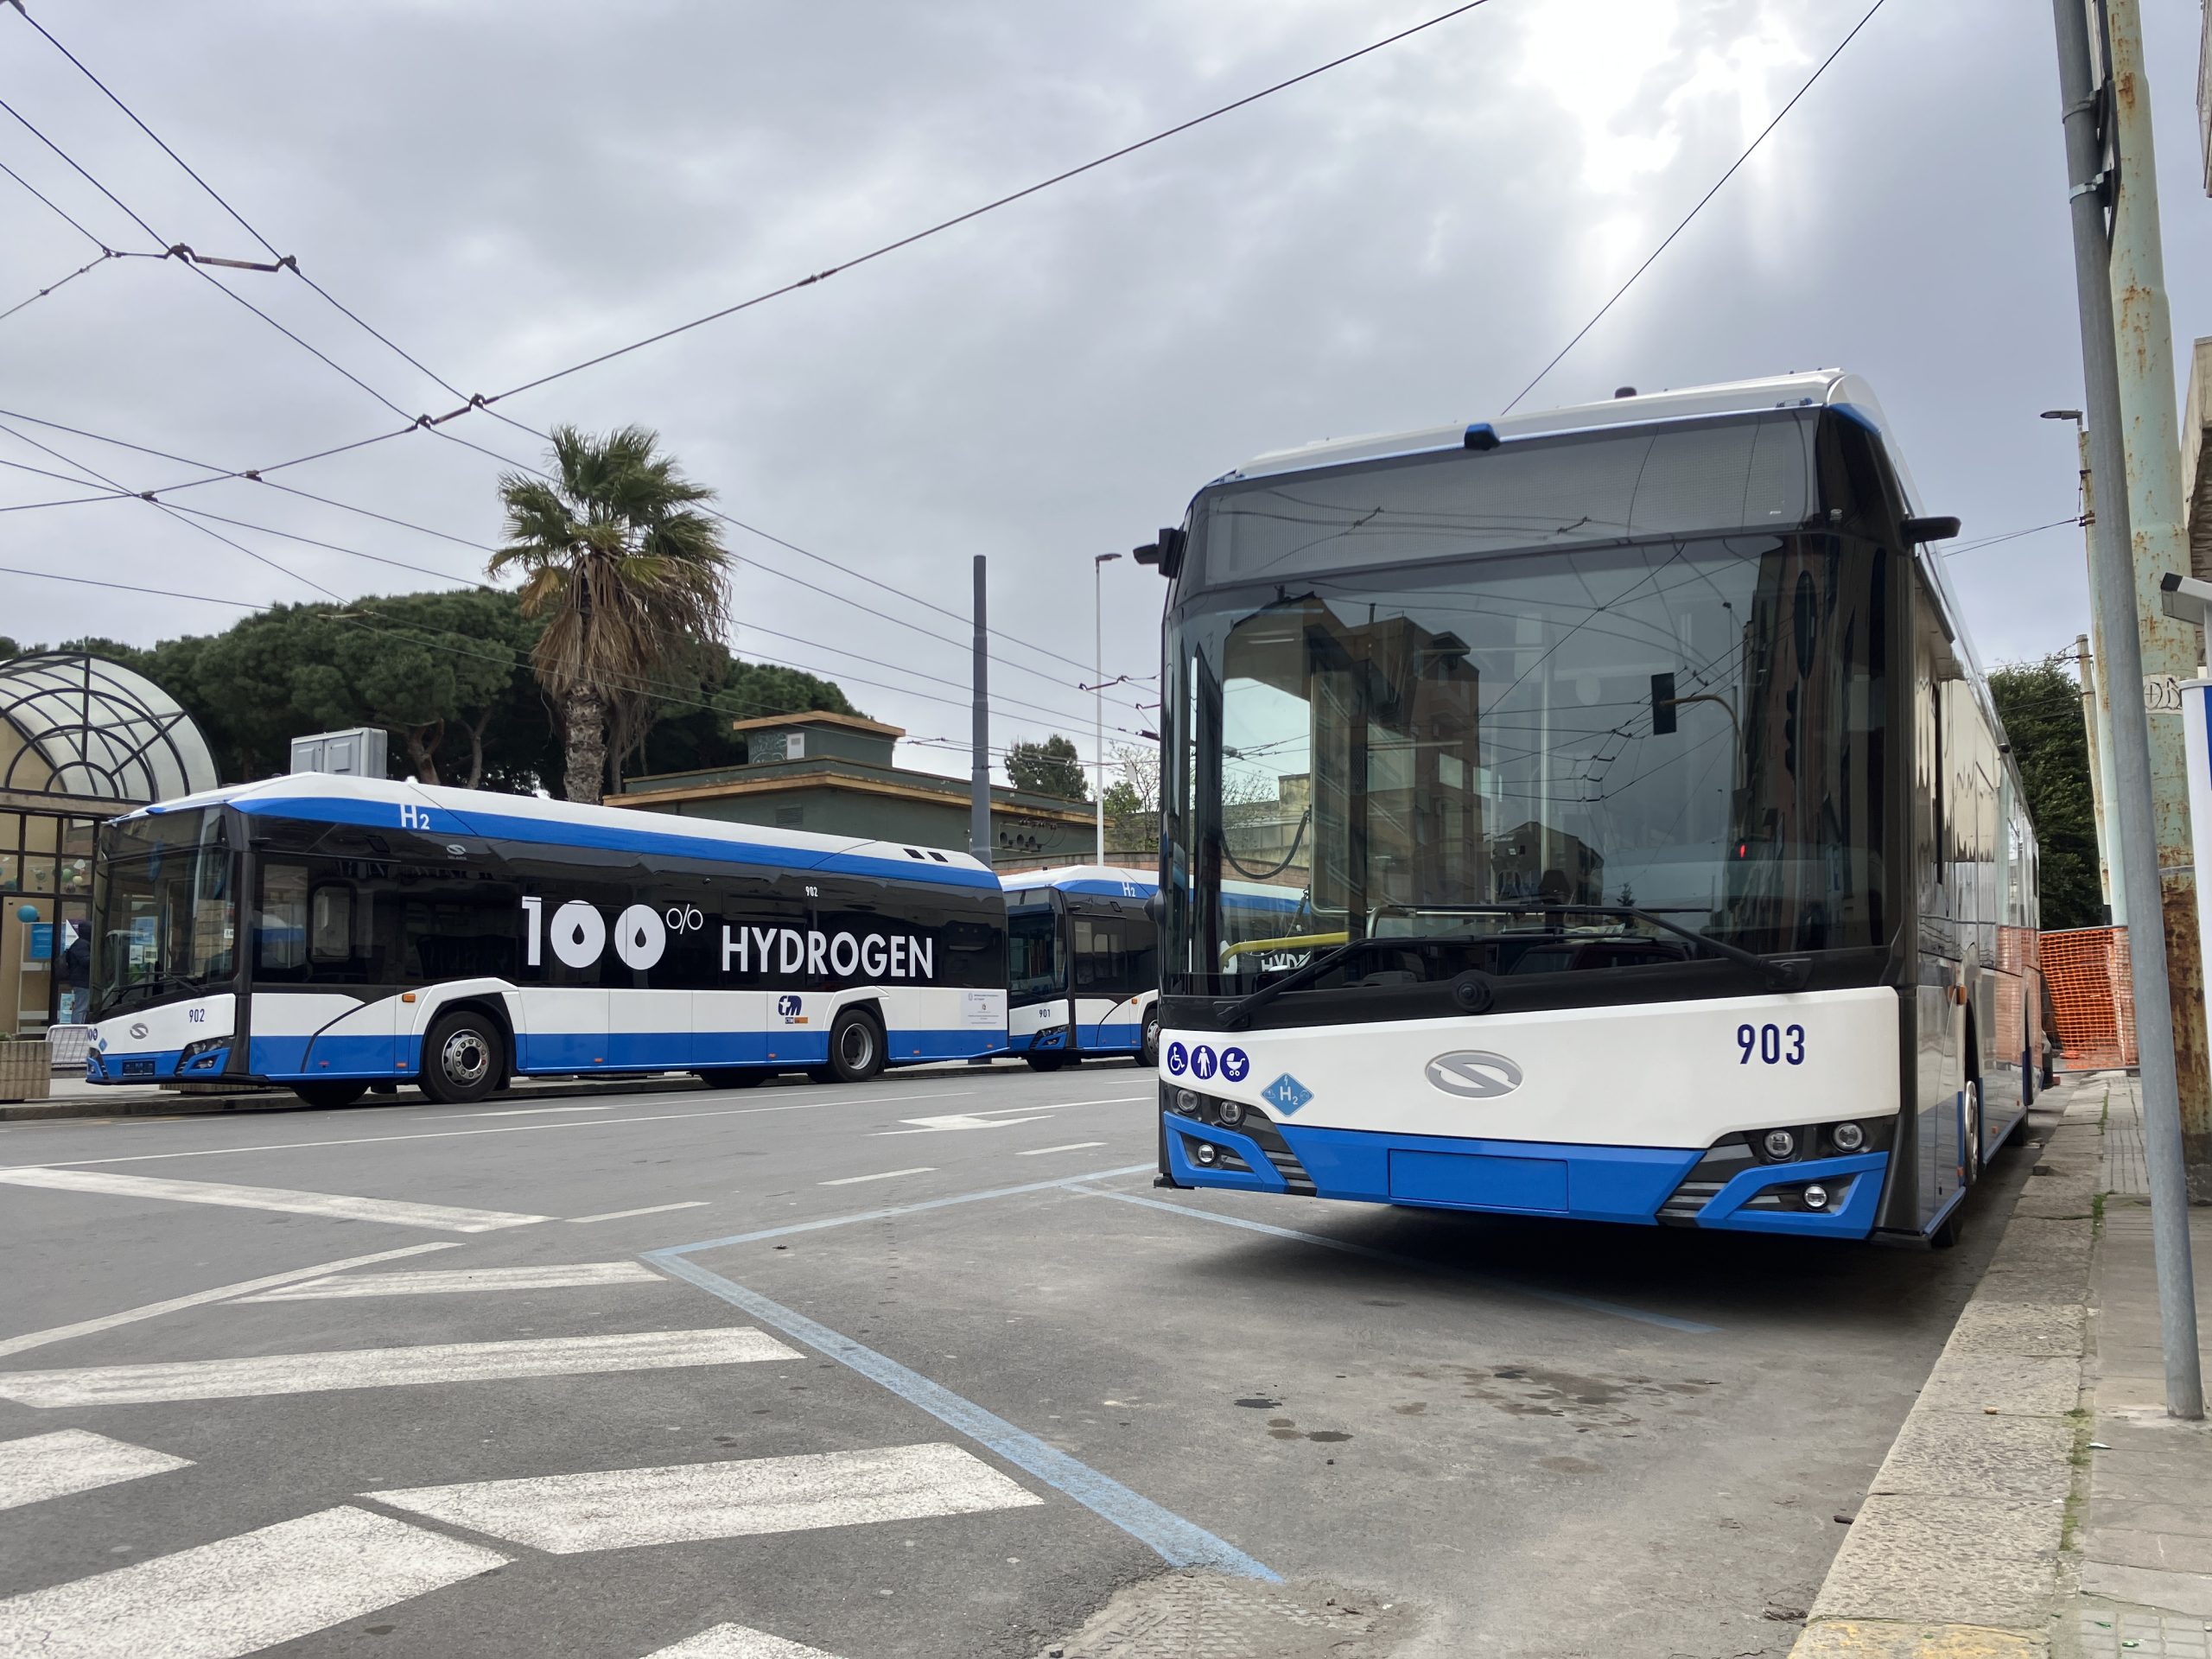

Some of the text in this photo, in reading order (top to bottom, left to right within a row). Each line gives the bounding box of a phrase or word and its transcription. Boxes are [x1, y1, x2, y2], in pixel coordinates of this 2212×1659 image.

[805, 886, 818, 897] 902
[521, 895, 933, 979] 100% HYDROGEN
[188, 1008, 205, 1023] 902
[1039, 1008, 1051, 1018] 901
[1737, 1023, 1805, 1065] 903
